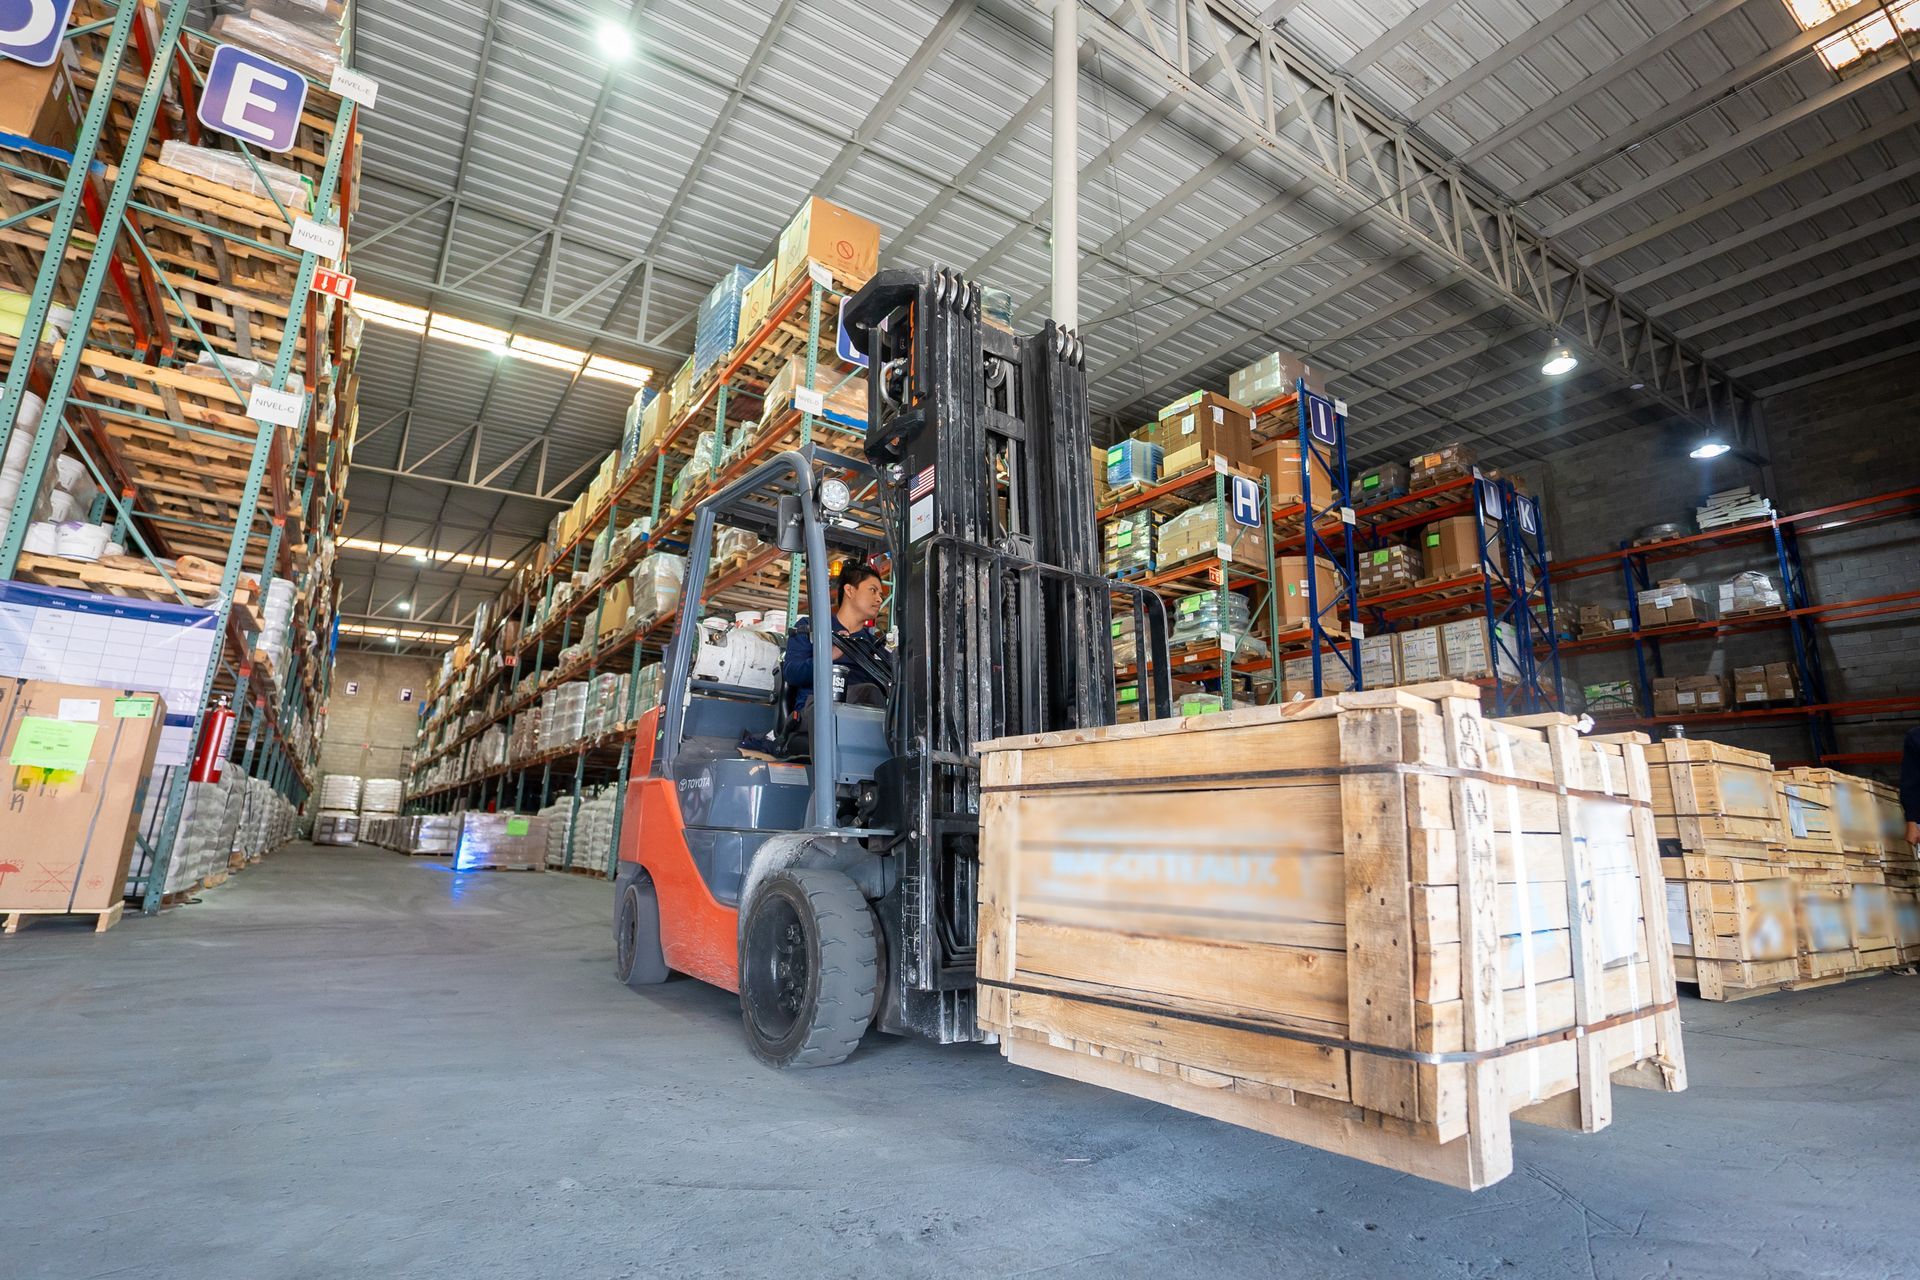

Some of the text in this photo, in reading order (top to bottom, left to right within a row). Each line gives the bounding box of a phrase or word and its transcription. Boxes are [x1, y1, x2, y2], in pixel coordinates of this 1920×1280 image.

[222, 62, 288, 141] E
[298, 229, 335, 247] NIVEL-D
[1235, 480, 1257, 521] H
[1519, 500, 1535, 532] K
[346, 681, 358, 695] E
[400, 688, 412, 701] F
[687, 777, 710, 789] TOYOTA
